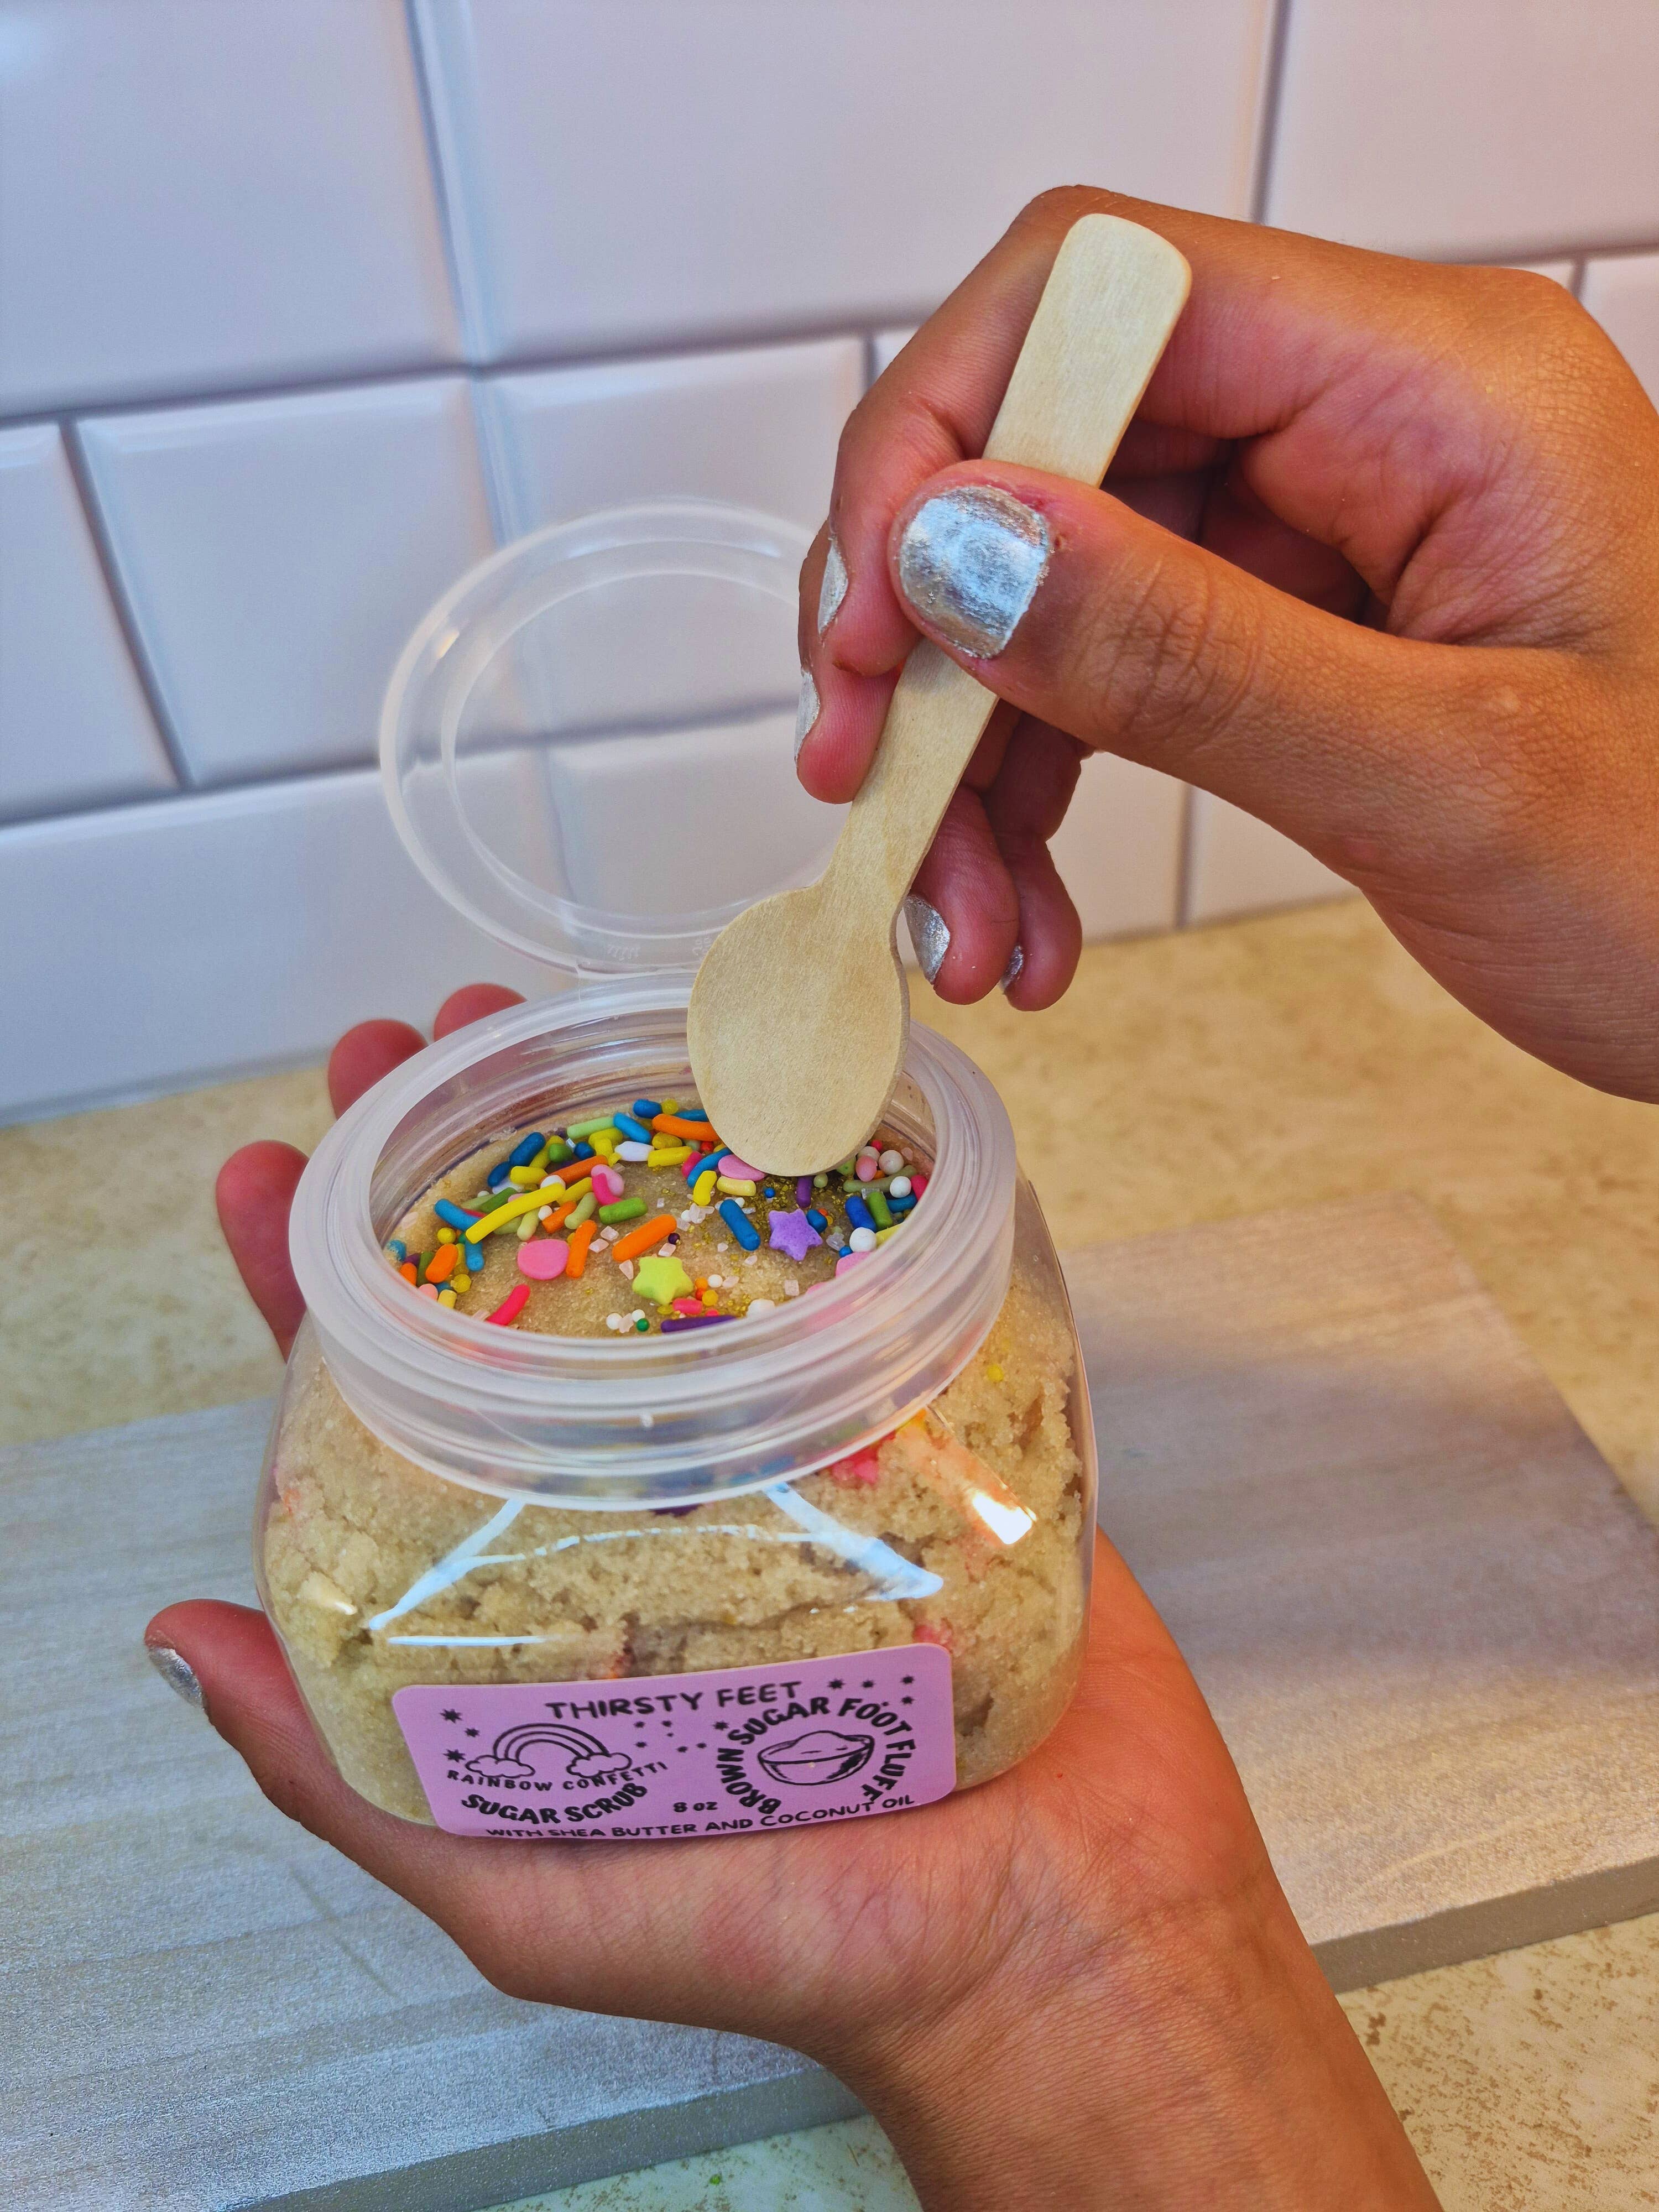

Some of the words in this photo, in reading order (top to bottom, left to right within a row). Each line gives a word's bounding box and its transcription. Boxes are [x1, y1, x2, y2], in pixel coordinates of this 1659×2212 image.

[545, 1692, 703, 1720] THIRSTY
[716, 1681, 802, 1708] FEET
[727, 1697, 831, 1745] SUGAR
[838, 1698, 912, 1736] FOOT
[447, 1770, 552, 1792] RAINBOW
[562, 1761, 669, 1790] CONFETTI
[716, 1747, 782, 1814] BROWN
[860, 1739, 916, 1802] FLUFF
[461, 1794, 561, 1824] SUGAR
[564, 1782, 648, 1822] SCRUB
[486, 1828, 542, 1837] WITH
[548, 1827, 607, 1837] SHEA
[611, 1825, 697, 1837] BUTTER
[705, 1818, 753, 1832] AND
[760, 1802, 875, 1826] COCONUT
[882, 1794, 915, 1809] OIL
[673, 1802, 687, 1813] 8
